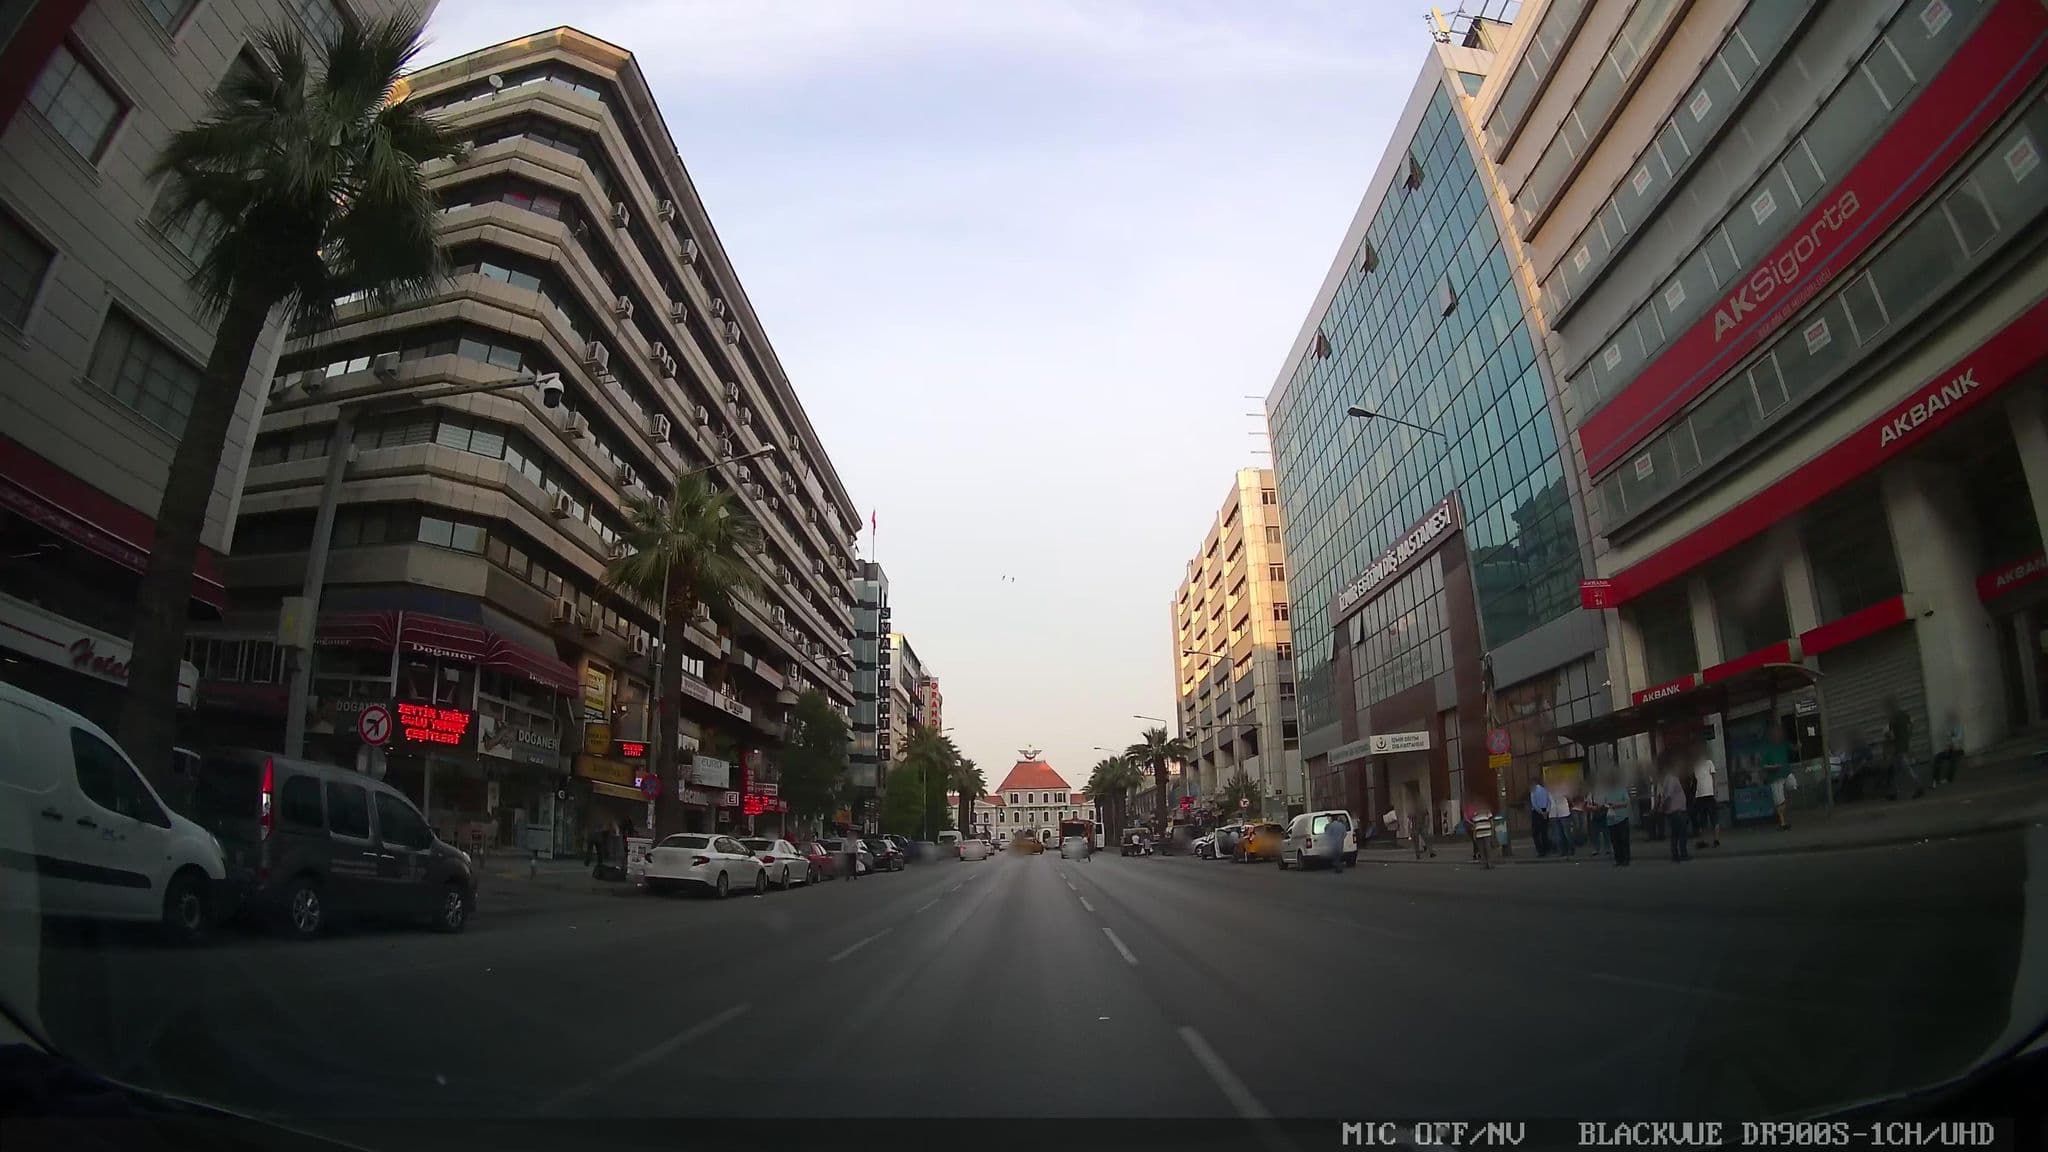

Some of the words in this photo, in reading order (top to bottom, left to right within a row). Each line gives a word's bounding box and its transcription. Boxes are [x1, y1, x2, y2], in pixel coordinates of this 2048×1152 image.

[1714, 190, 1861, 343] AKSigorta
[1881, 367, 1981, 448] AKBANK
[930, 682, 938, 726] GRAND
[1642, 683, 1681, 704] AKBANK
[702, 759, 722, 769] EURO
